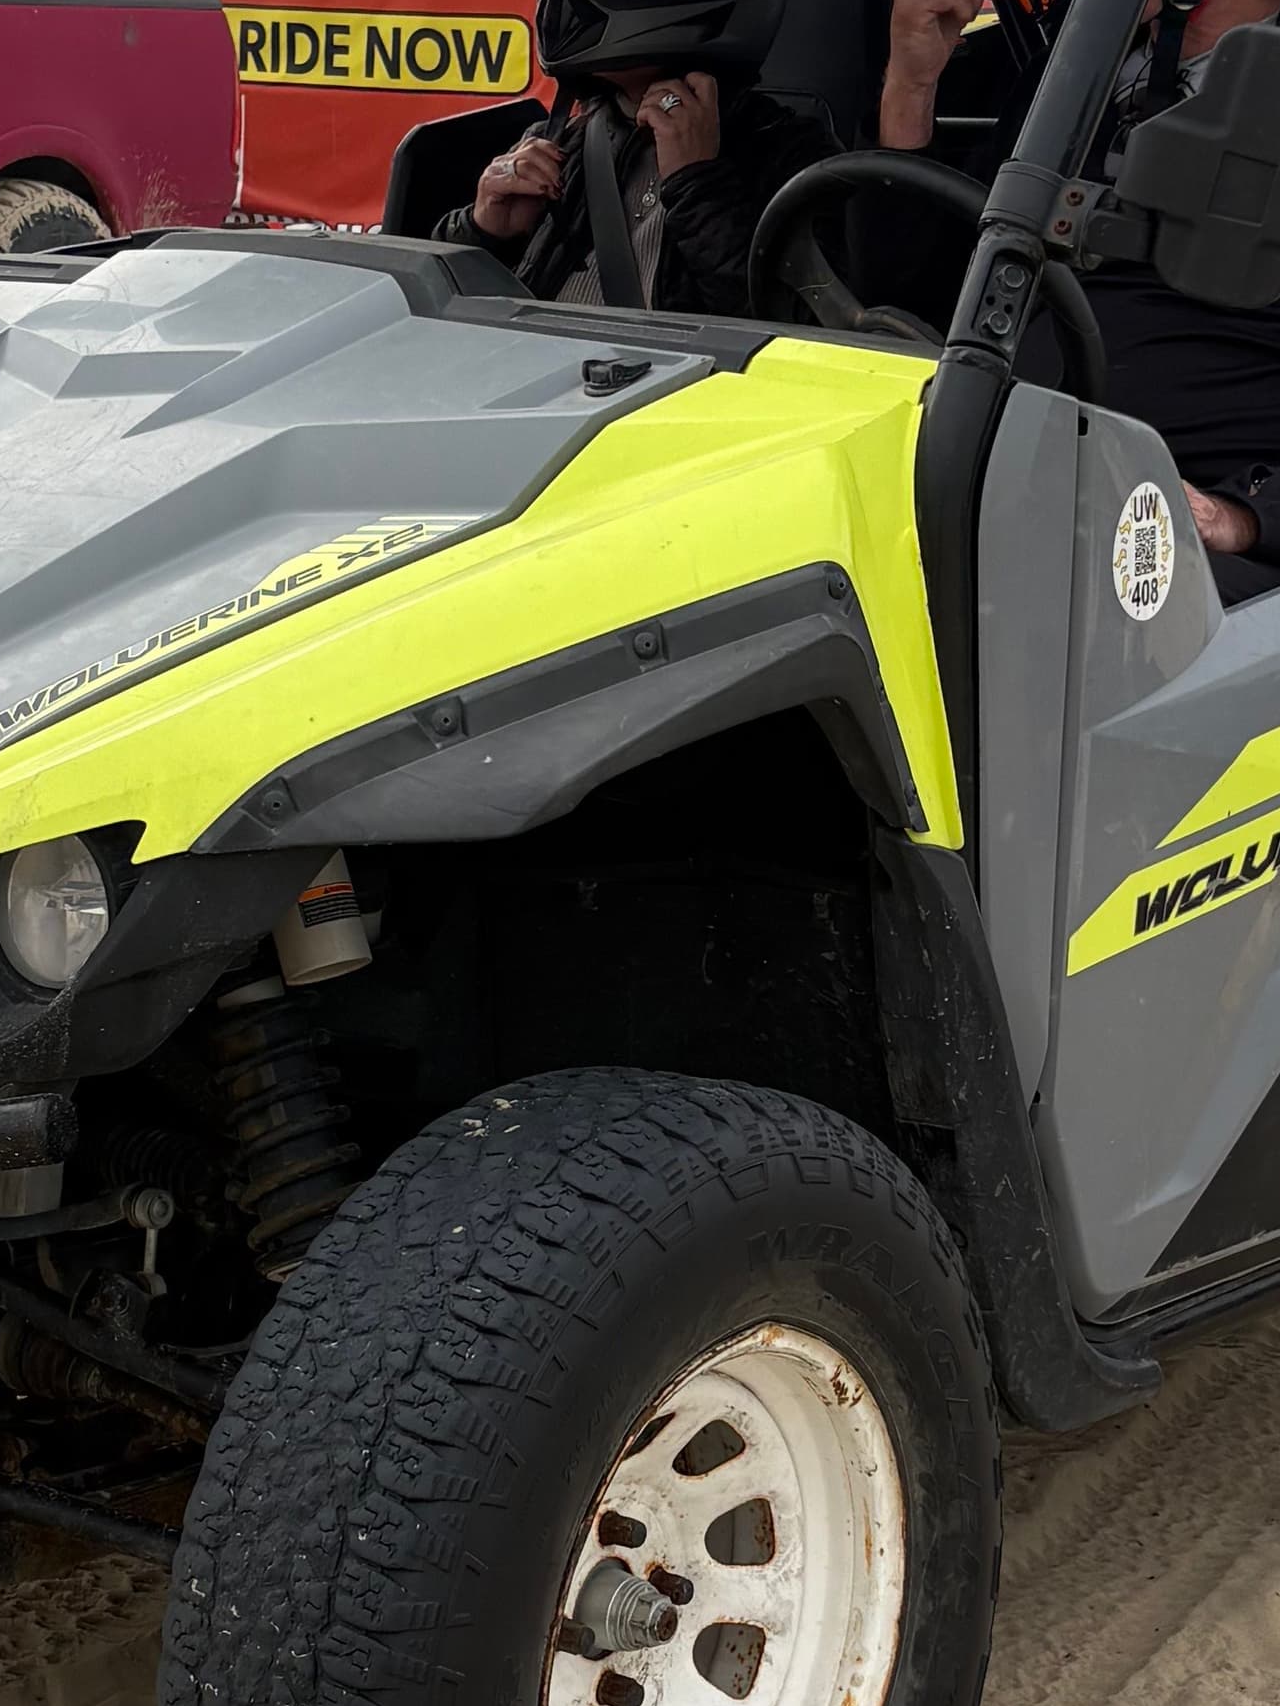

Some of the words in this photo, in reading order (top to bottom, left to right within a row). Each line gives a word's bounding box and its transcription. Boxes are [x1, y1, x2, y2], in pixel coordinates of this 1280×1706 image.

[239, 21, 351, 77] RIDE
[366, 26, 512, 83] NOW
[1133, 493, 1159, 523] UW
[1131, 578, 1159, 607] 408
